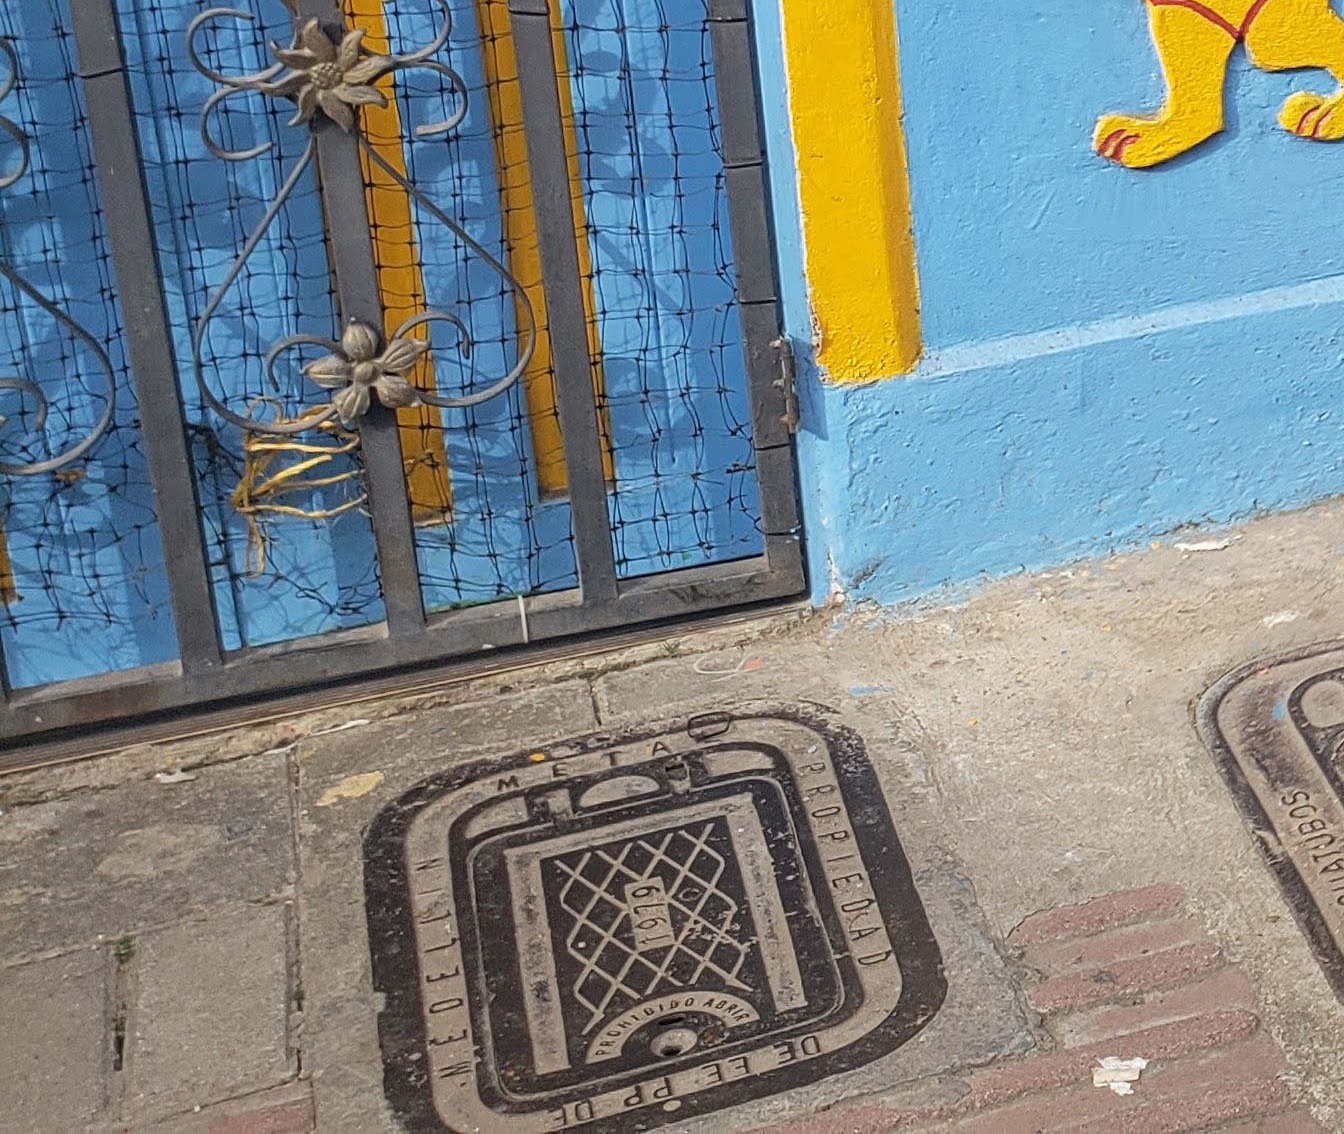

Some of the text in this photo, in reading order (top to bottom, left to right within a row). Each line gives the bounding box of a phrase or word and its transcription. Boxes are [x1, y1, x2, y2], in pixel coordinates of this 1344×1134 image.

[796, 761, 893, 967] PROPIEDAD
[631, 884, 673, 945] 1979
[414, 856, 473, 1080] MEDELLIN
[594, 997, 751, 1057] PROHIBIDO ABRIR
[772, 1034, 822, 1065] DE
[621, 1077, 674, 1108] PP
[700, 1056, 750, 1087] EE
